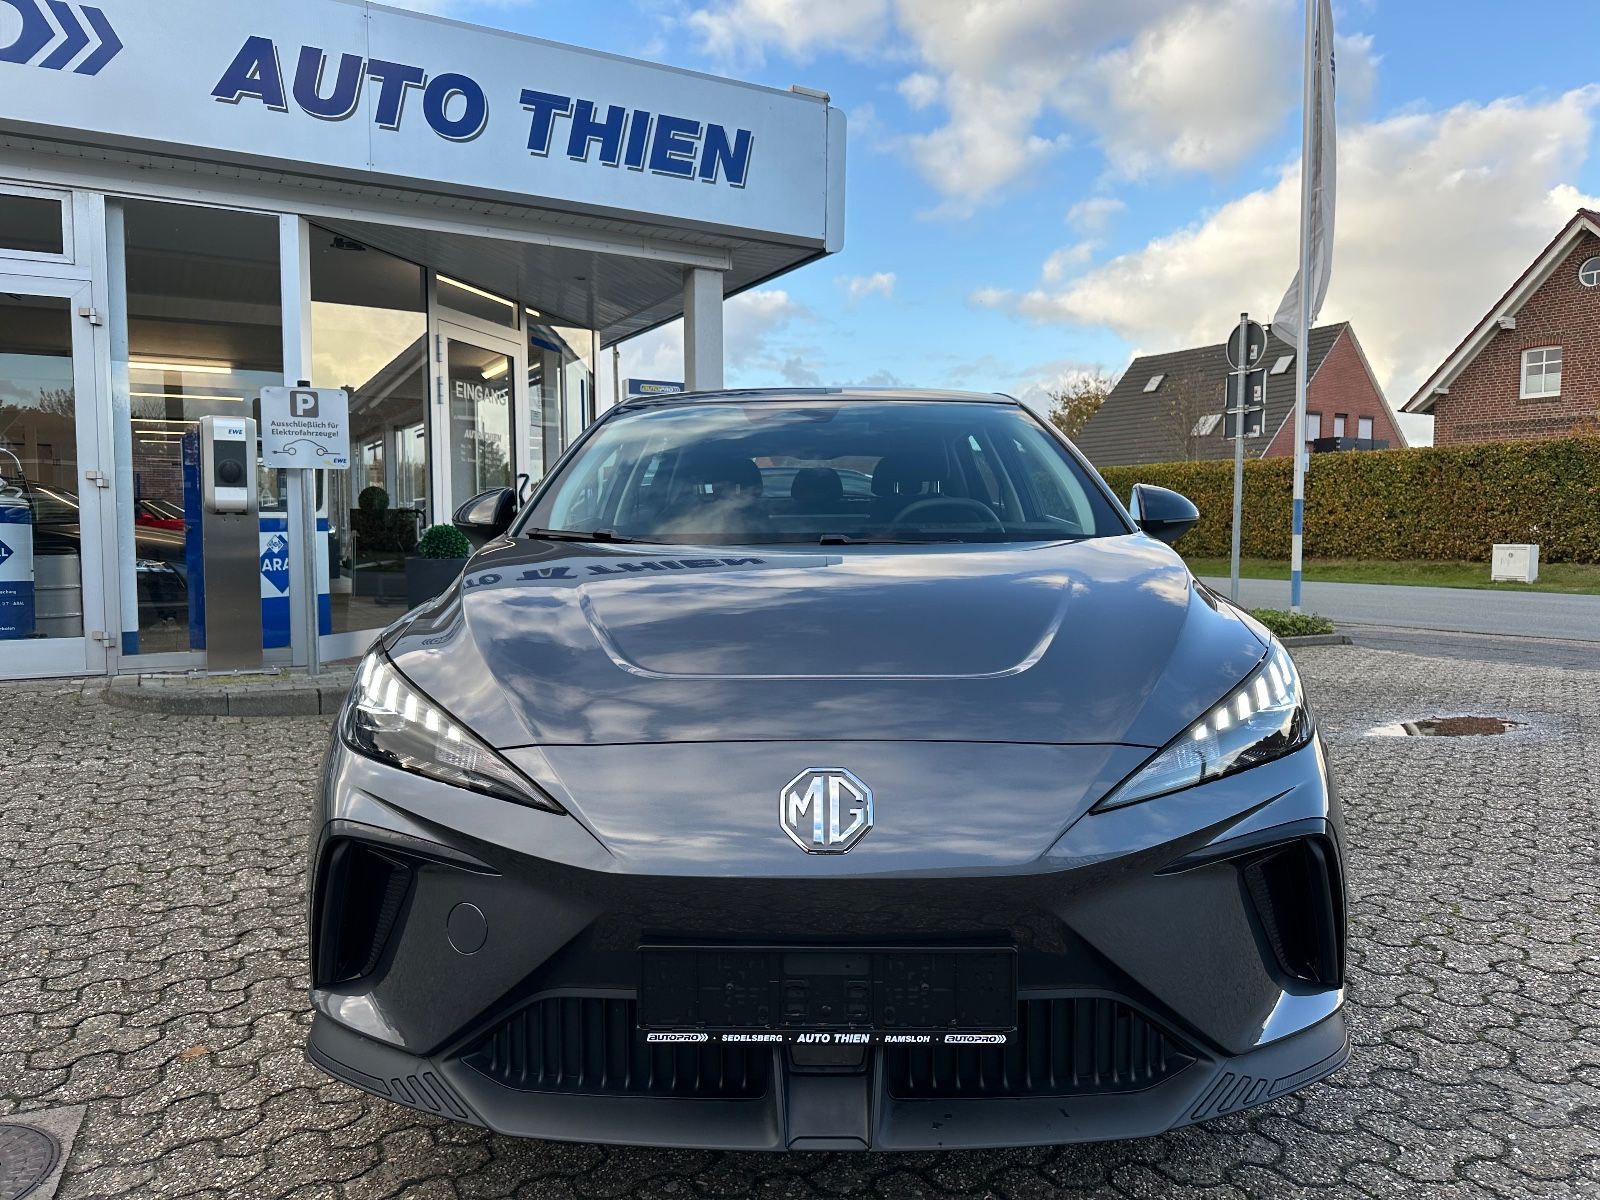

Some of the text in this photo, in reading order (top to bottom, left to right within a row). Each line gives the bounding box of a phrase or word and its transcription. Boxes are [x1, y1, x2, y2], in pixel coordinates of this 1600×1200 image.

[211, 35, 754, 188] AUTO THIEN
[296, 393, 315, 416] P
[455, 380, 507, 406] EINGANG
[270, 420, 339, 430] Ausschließlich für
[271, 428, 339, 438] Elektrofahrzeuge!
[788, 775, 865, 845] MG
[721, 1034, 783, 1043] SEDELSBERG
[797, 1033, 831, 1043] AUTO
[833, 1033, 870, 1043] THIEN
[884, 1035, 930, 1043] RAMSLOH
